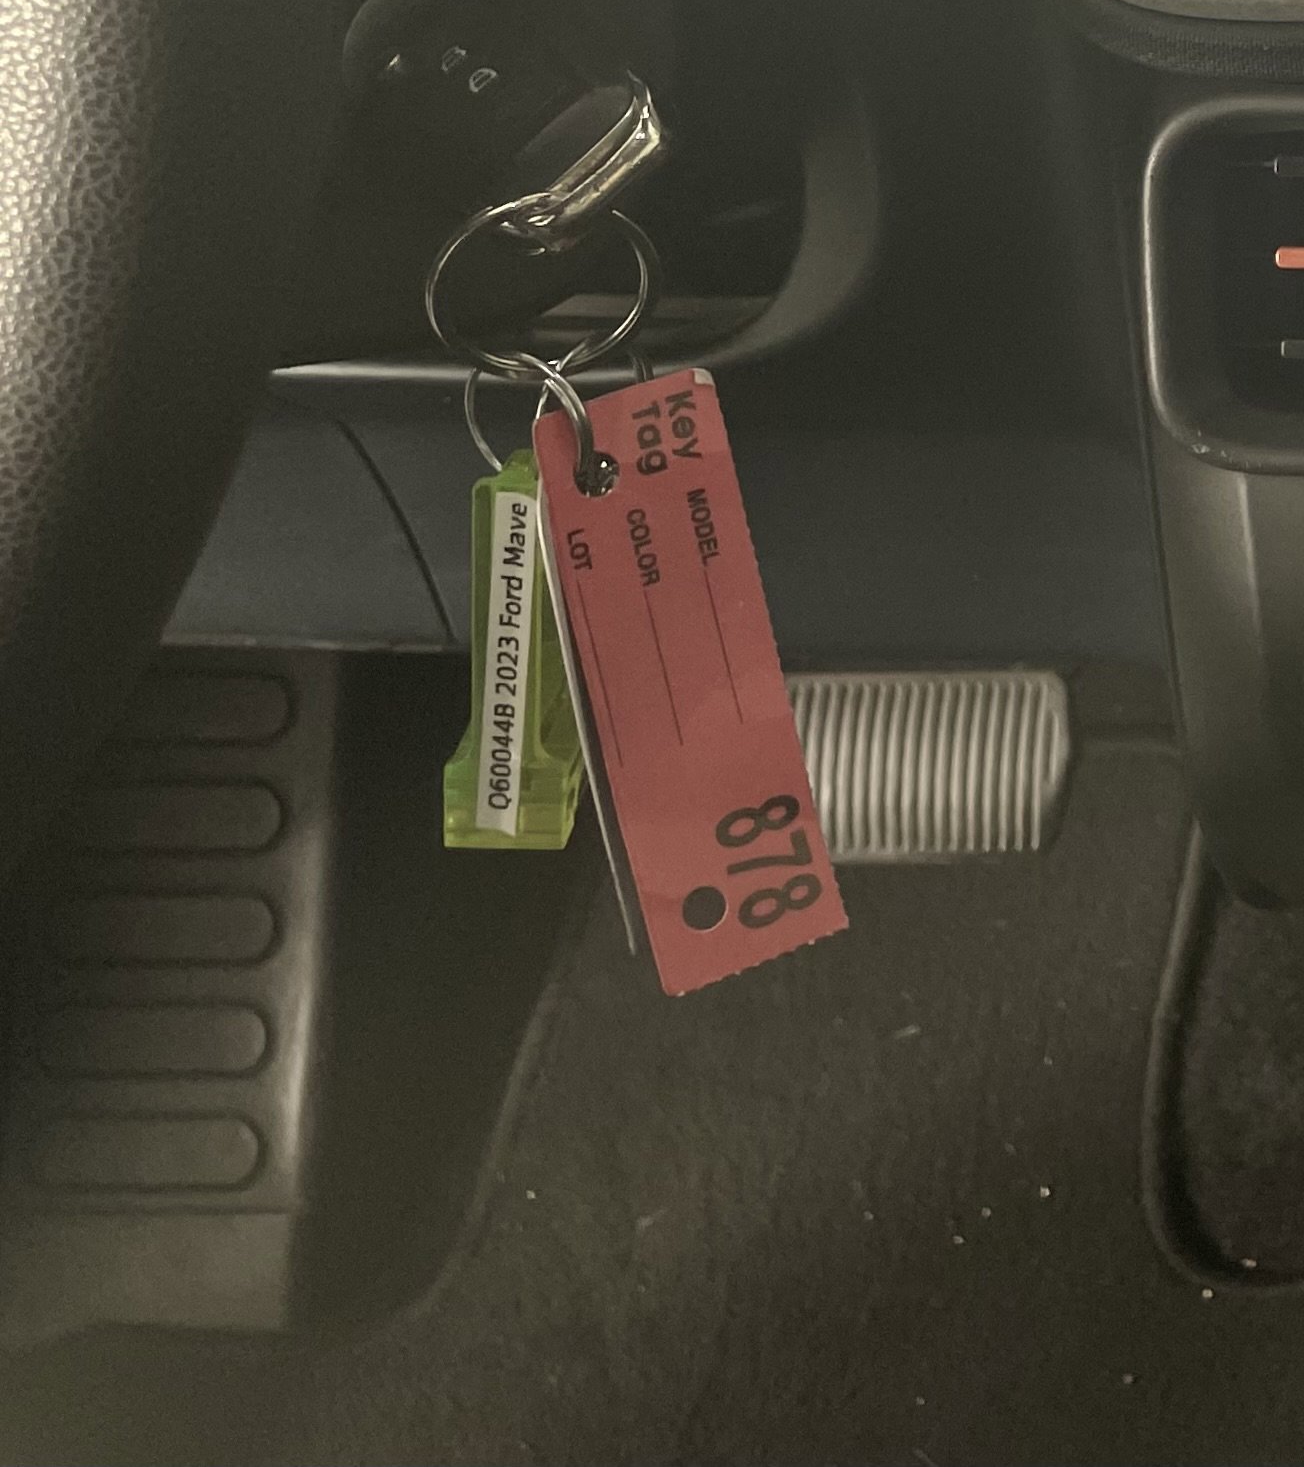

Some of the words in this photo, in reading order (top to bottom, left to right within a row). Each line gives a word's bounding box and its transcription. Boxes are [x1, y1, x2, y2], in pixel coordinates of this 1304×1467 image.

[632, 401, 668, 475] Tag
[665, 390, 702, 460] Key
[504, 502, 527, 567] Mave
[567, 528, 592, 570] LOT
[626, 509, 660, 587] COLOR
[686, 488, 720, 566] MODEL
[500, 576, 523, 628] Ford
[496, 636, 519, 696] 2023
[489, 703, 514, 810] Q60044B
[715, 794, 822, 930] 878
